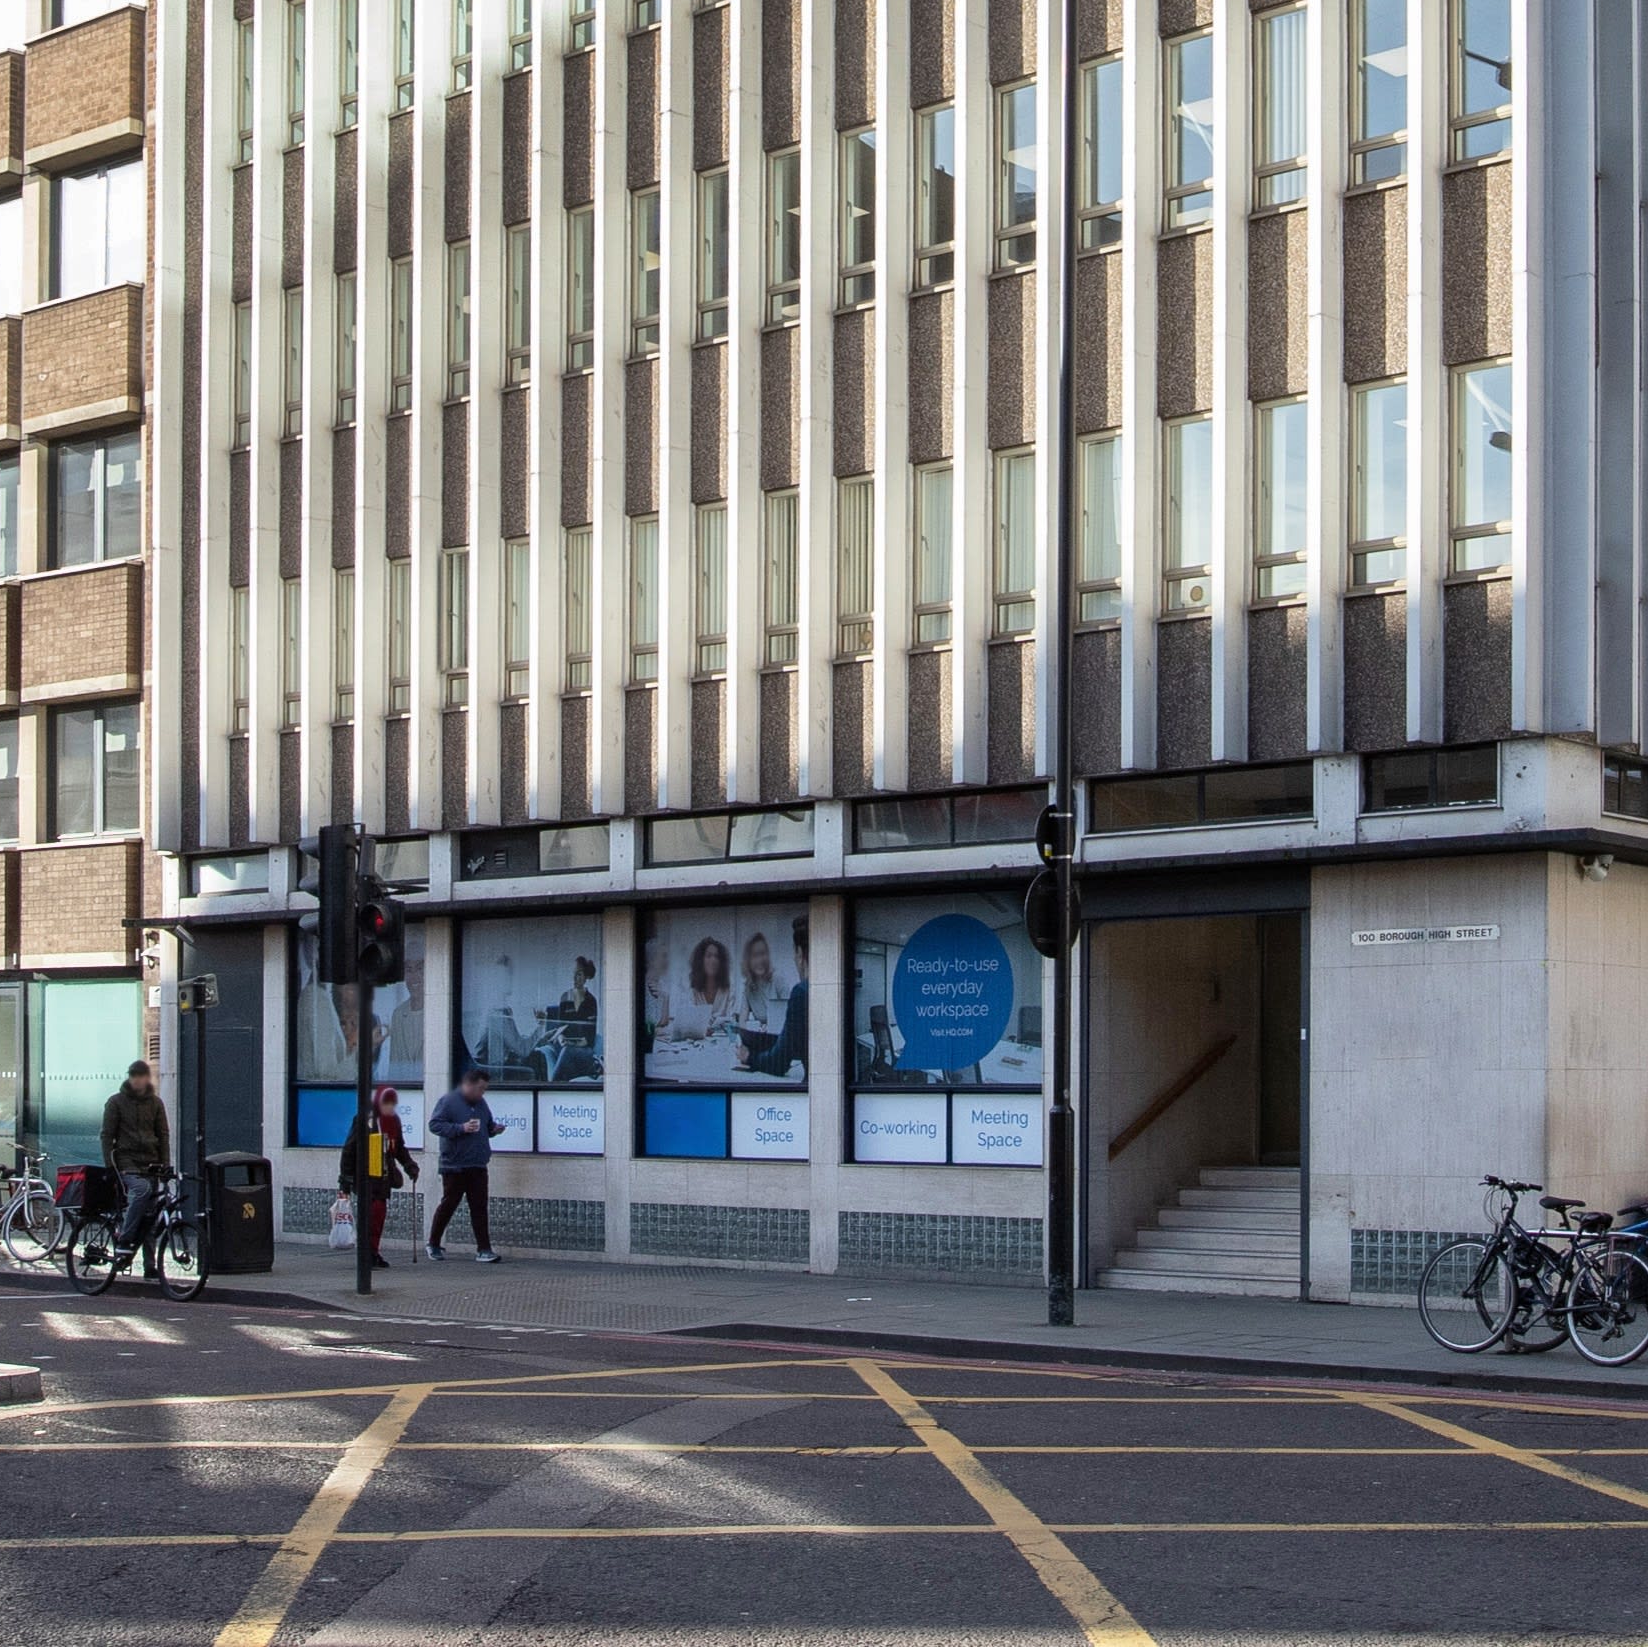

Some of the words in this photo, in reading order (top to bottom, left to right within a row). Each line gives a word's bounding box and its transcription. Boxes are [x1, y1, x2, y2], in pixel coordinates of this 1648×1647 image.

[1358, 933, 1375, 942] 100
[1379, 931, 1424, 942] BOROUGH
[1428, 929, 1451, 940] HIGH
[1456, 928, 1493, 938] STREET
[907, 957, 999, 976] Ready-to-use
[921, 979, 984, 998] everyday
[916, 1002, 989, 1020] workspace
[552, 1105, 598, 1121] Meeting
[756, 1107, 792, 1121] Office
[971, 1110, 1029, 1128] Meeting
[495, 1114, 527, 1130] orking
[860, 1120, 937, 1139] Co-working
[557, 1125, 593, 1140] Space
[755, 1128, 794, 1143] Space
[977, 1132, 1023, 1150] Space
